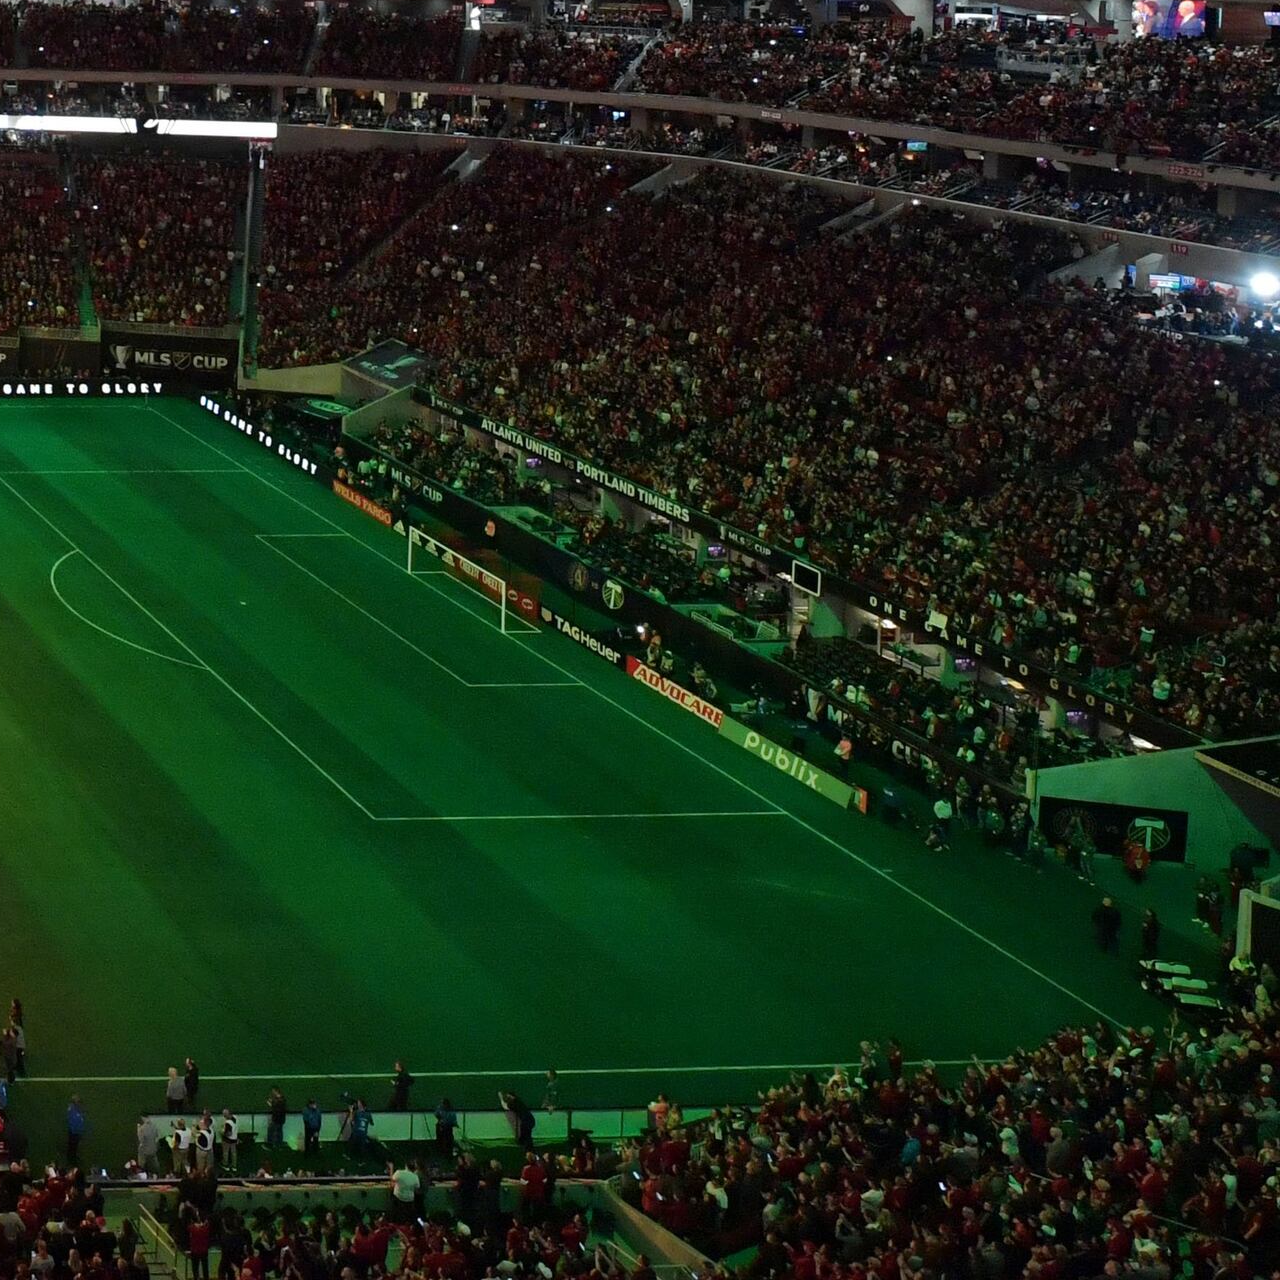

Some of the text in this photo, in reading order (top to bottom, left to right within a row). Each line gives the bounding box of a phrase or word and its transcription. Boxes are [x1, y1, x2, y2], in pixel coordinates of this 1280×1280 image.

[134, 351, 228, 370] MLS CUP
[2, 383, 53, 395] GAME
[66, 383, 89, 395] TO
[101, 383, 162, 394] GLORY
[224, 410, 253, 435] GAME
[258, 431, 272, 447] TO
[278, 444, 317, 475] GLORY
[391, 466, 444, 504] MLS CUP
[481, 418, 524, 449] ATLANTA
[525, 438, 562, 465] UNITED
[576, 459, 636, 498] PORTLAND
[637, 486, 691, 523] TIMBERS
[333, 481, 392, 525] WELLS FARGO
[754, 543, 771, 556] CUP
[869, 595, 907, 621] ONE
[1001, 655, 1029, 677] TO
[1049, 677, 1134, 725] GLORY
[635, 667, 724, 727] ADVOCARE
